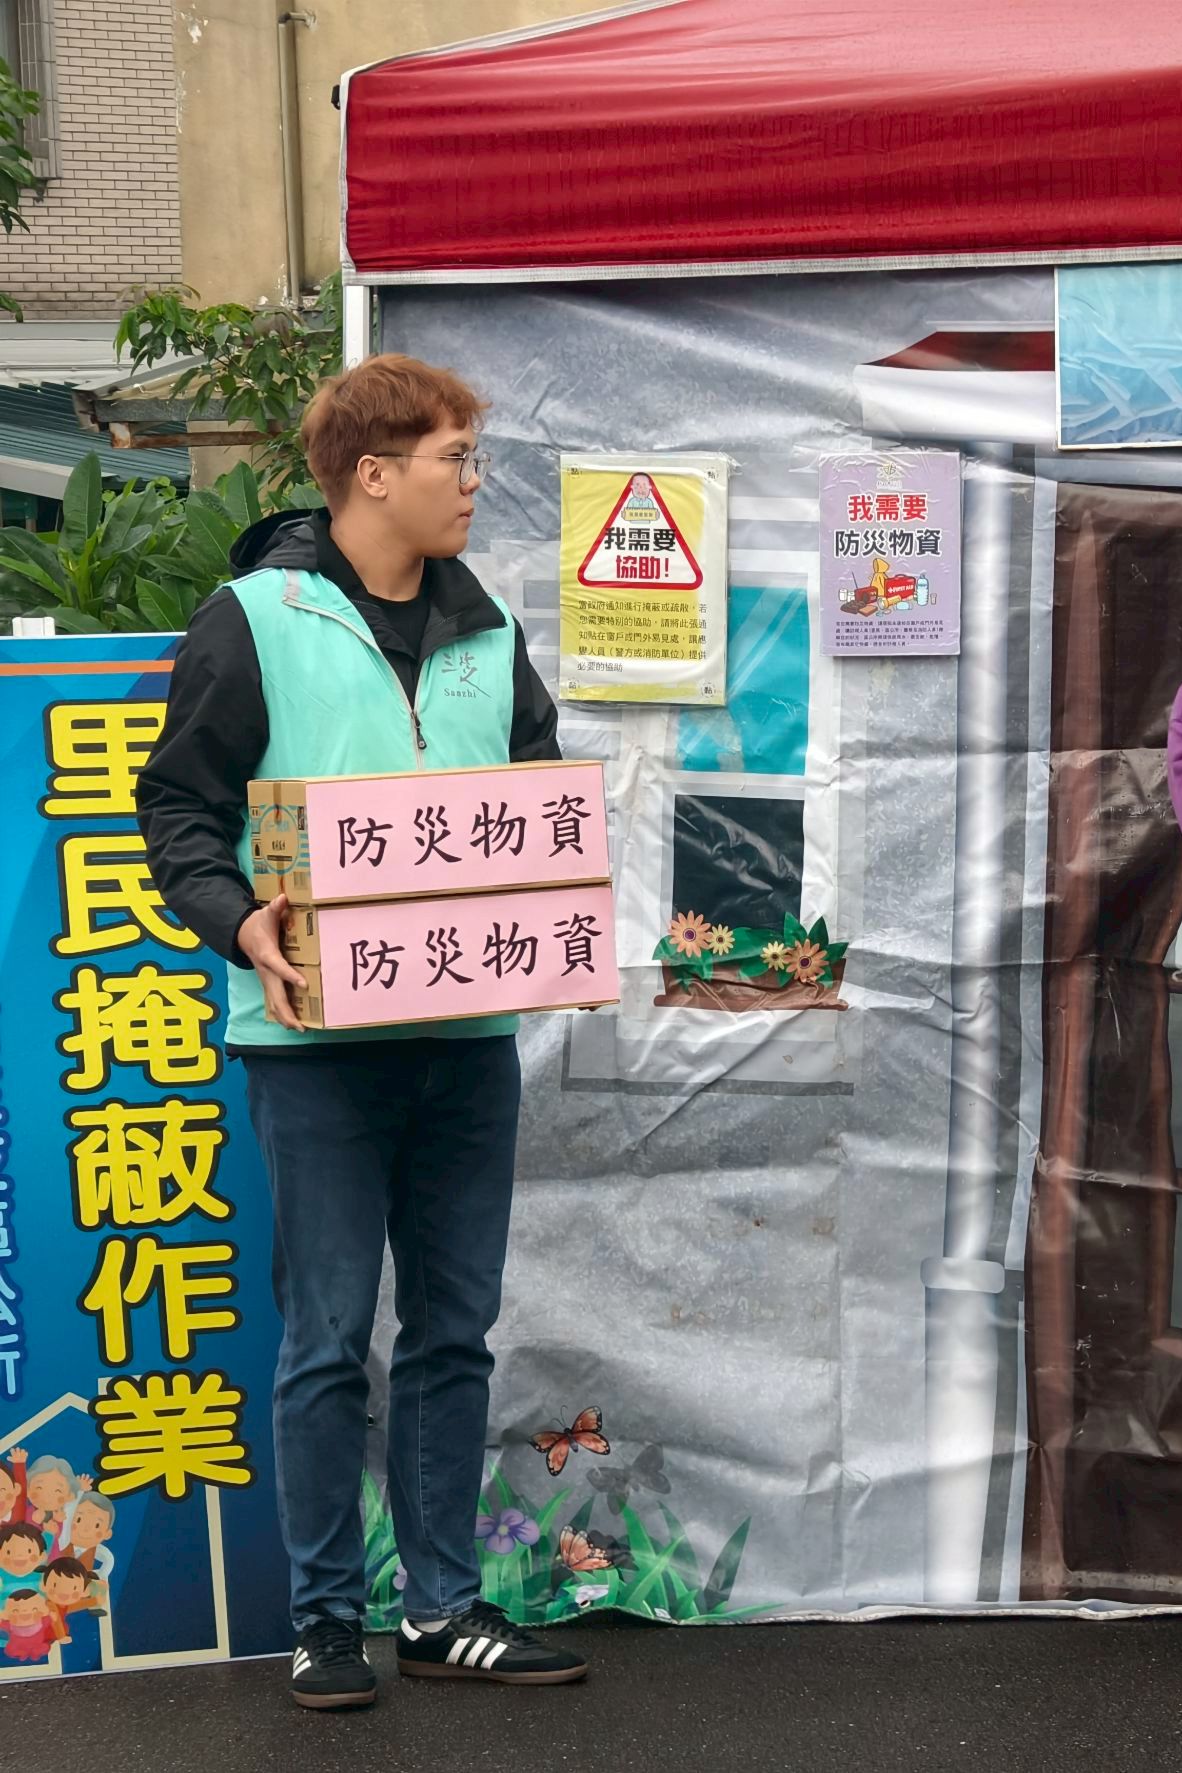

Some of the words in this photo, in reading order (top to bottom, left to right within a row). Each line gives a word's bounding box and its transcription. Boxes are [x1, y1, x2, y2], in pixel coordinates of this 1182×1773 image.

[848, 493, 928, 522] 我需要
[604, 527, 677, 551] 我需要
[834, 529, 942, 557] 防災物資
[577, 661, 623, 673] 必要的協助
[443, 687, 477, 699] Sanzhi
[337, 793, 592, 869] 防災物資
[349, 912, 603, 991] 防災物資
[41, 700, 253, 1499] 里民掩蔽作業
